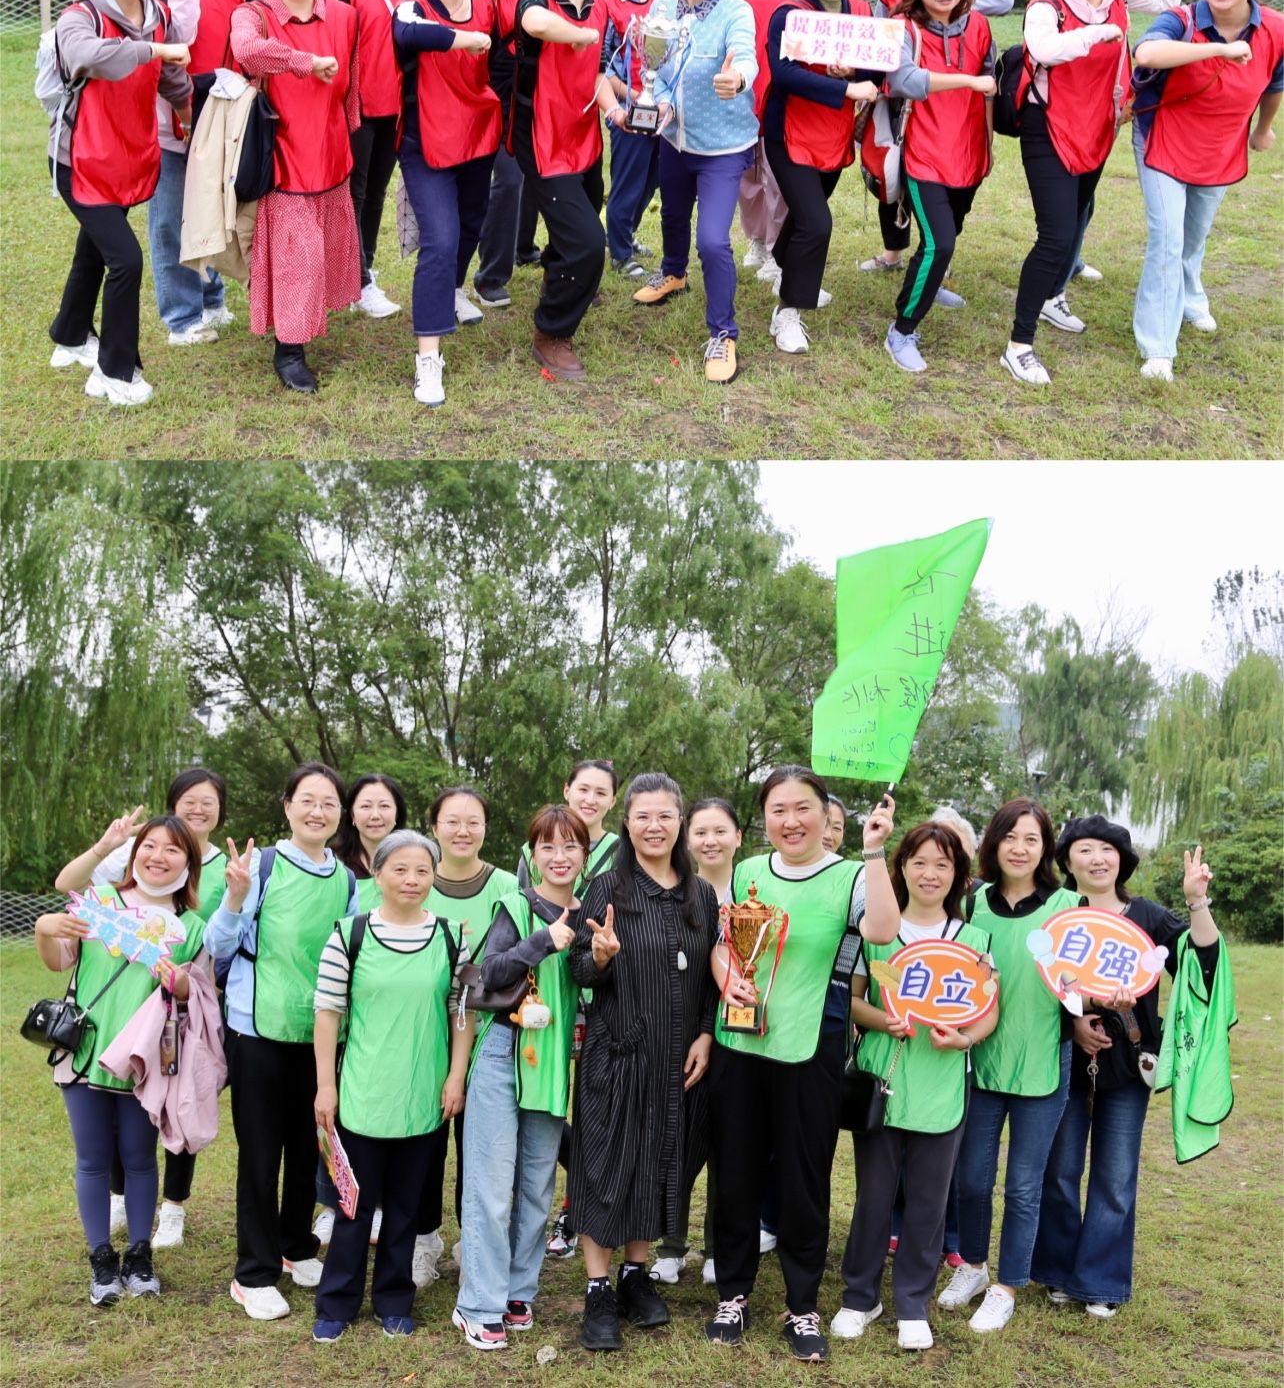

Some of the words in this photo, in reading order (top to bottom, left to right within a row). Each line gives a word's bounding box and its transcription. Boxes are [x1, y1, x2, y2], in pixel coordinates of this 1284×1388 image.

[792, 15, 876, 40] 提质增效
[812, 39, 896, 65] 芳华尽绽
[1058, 927, 1139, 984] 自强
[901, 962, 975, 1006] 自立
